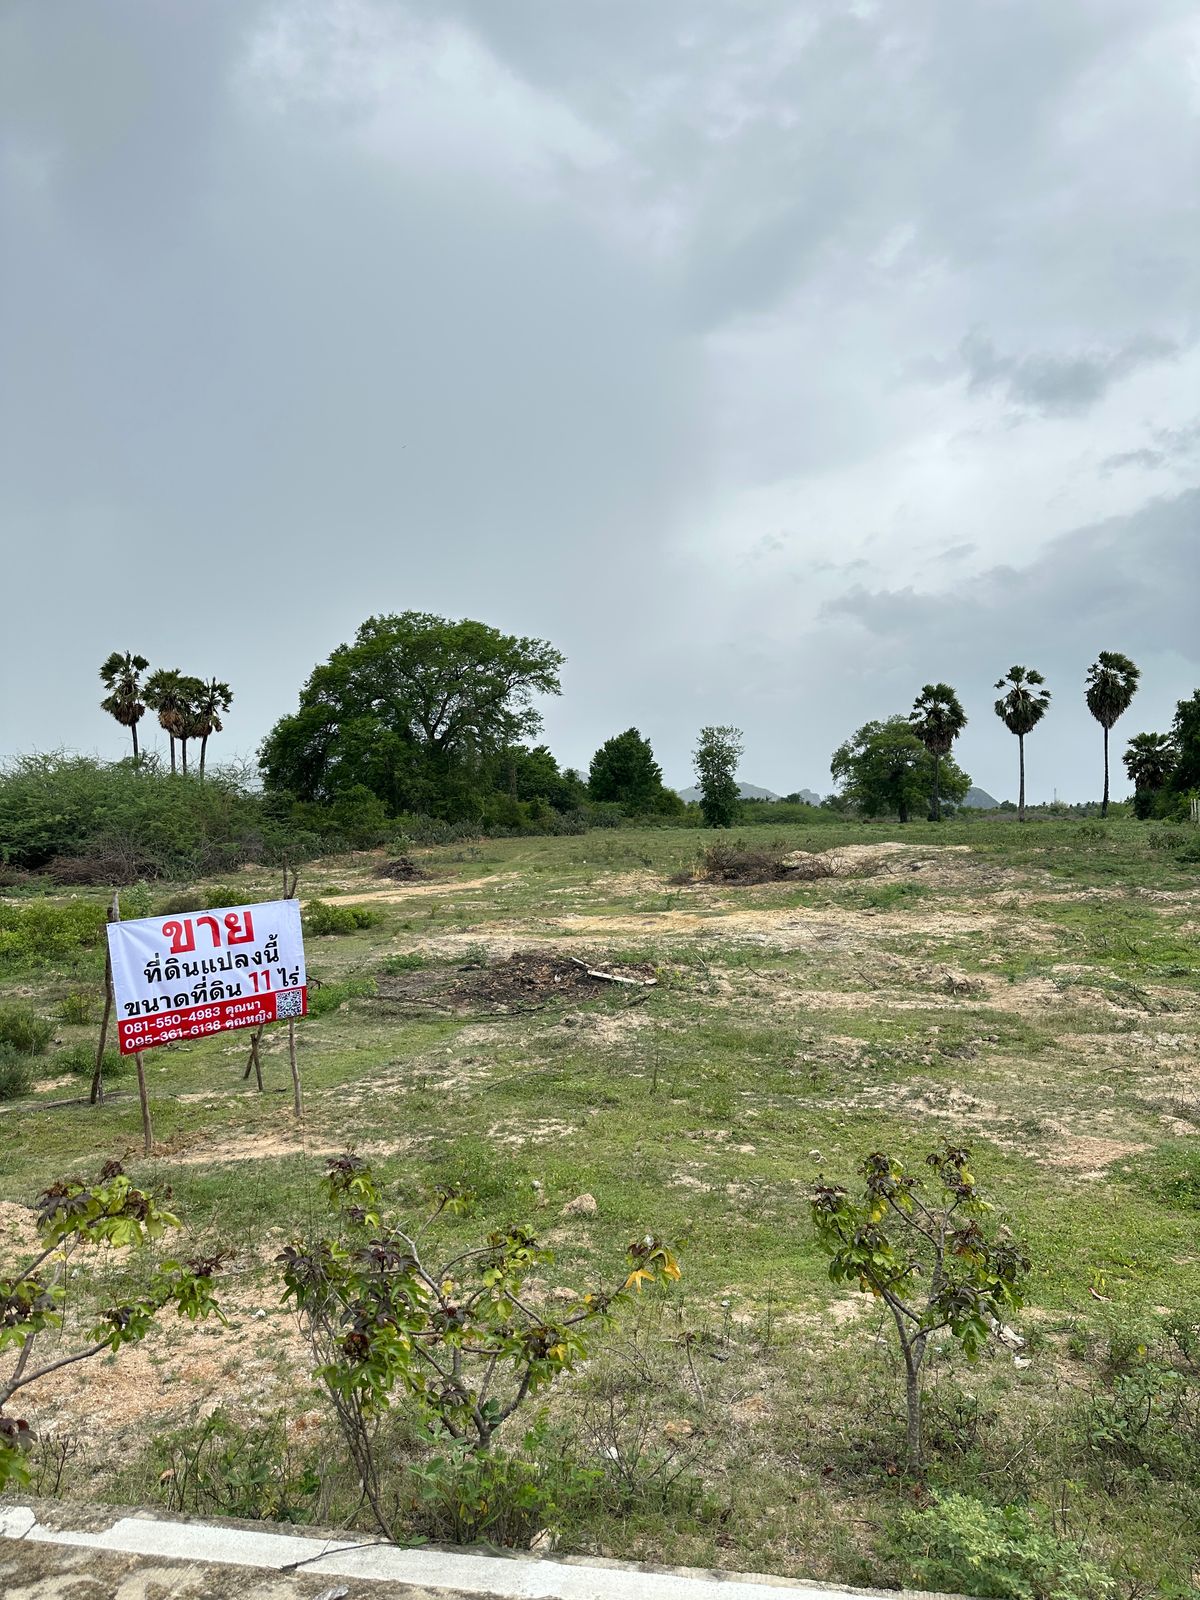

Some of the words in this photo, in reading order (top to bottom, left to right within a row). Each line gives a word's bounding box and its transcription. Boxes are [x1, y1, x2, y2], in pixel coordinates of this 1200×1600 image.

[162, 911, 255, 954] ขาย
[143, 933, 280, 984] ที่ดินแปลงนี้
[124, 976, 242, 1016] ขนาดที่ดิน
[248, 969, 272, 993] 11
[277, 966, 300, 988] ไร่
[124, 1006, 221, 1035] 081-550-4983
[225, 1000, 261, 1018] คุณนา
